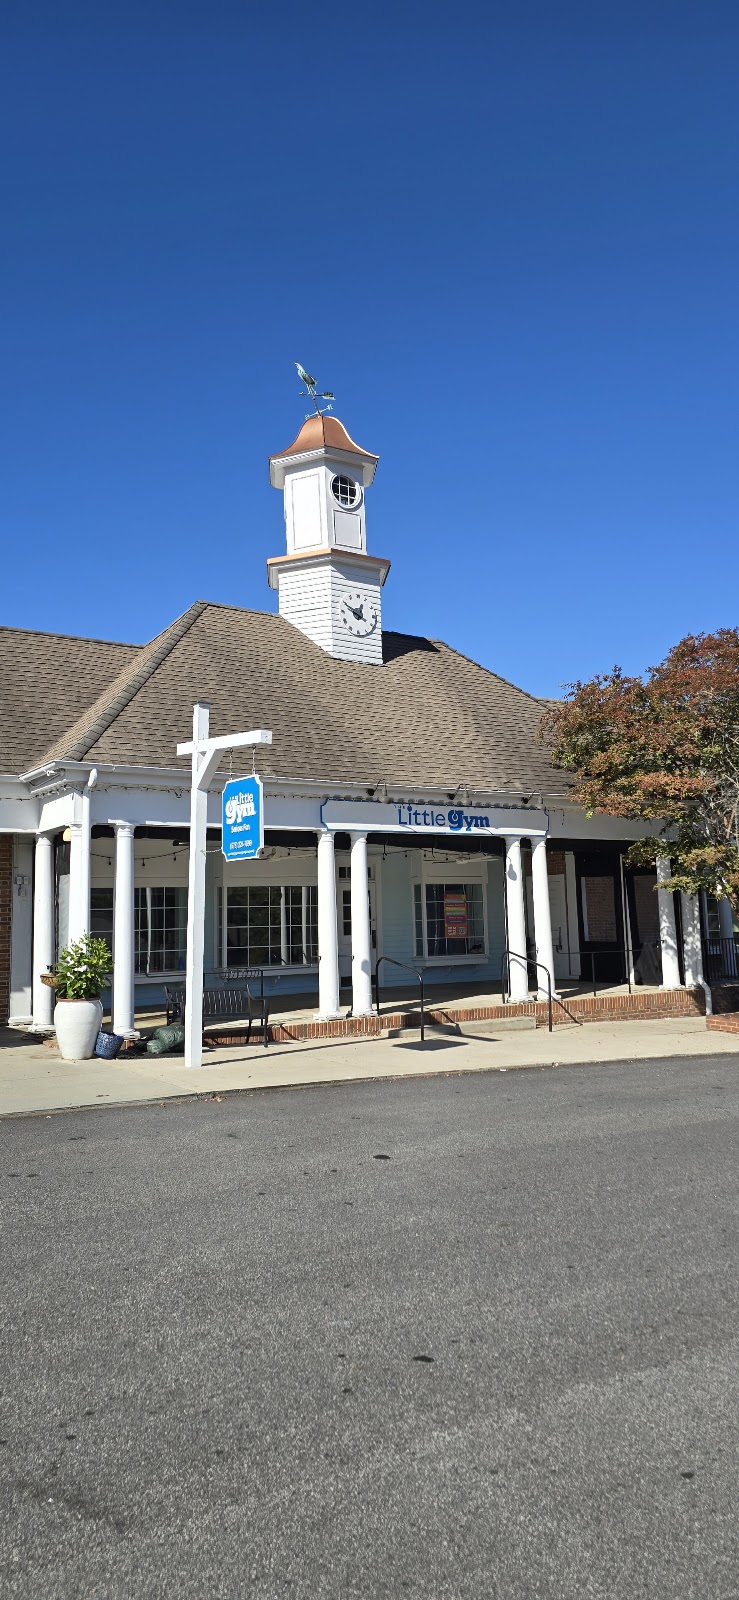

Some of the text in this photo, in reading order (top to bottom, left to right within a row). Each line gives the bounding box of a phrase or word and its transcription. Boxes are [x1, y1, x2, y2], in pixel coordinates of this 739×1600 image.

[236, 792, 254, 805] Little
[225, 800, 255, 825] gym
[398, 804, 490, 831] Little gym
